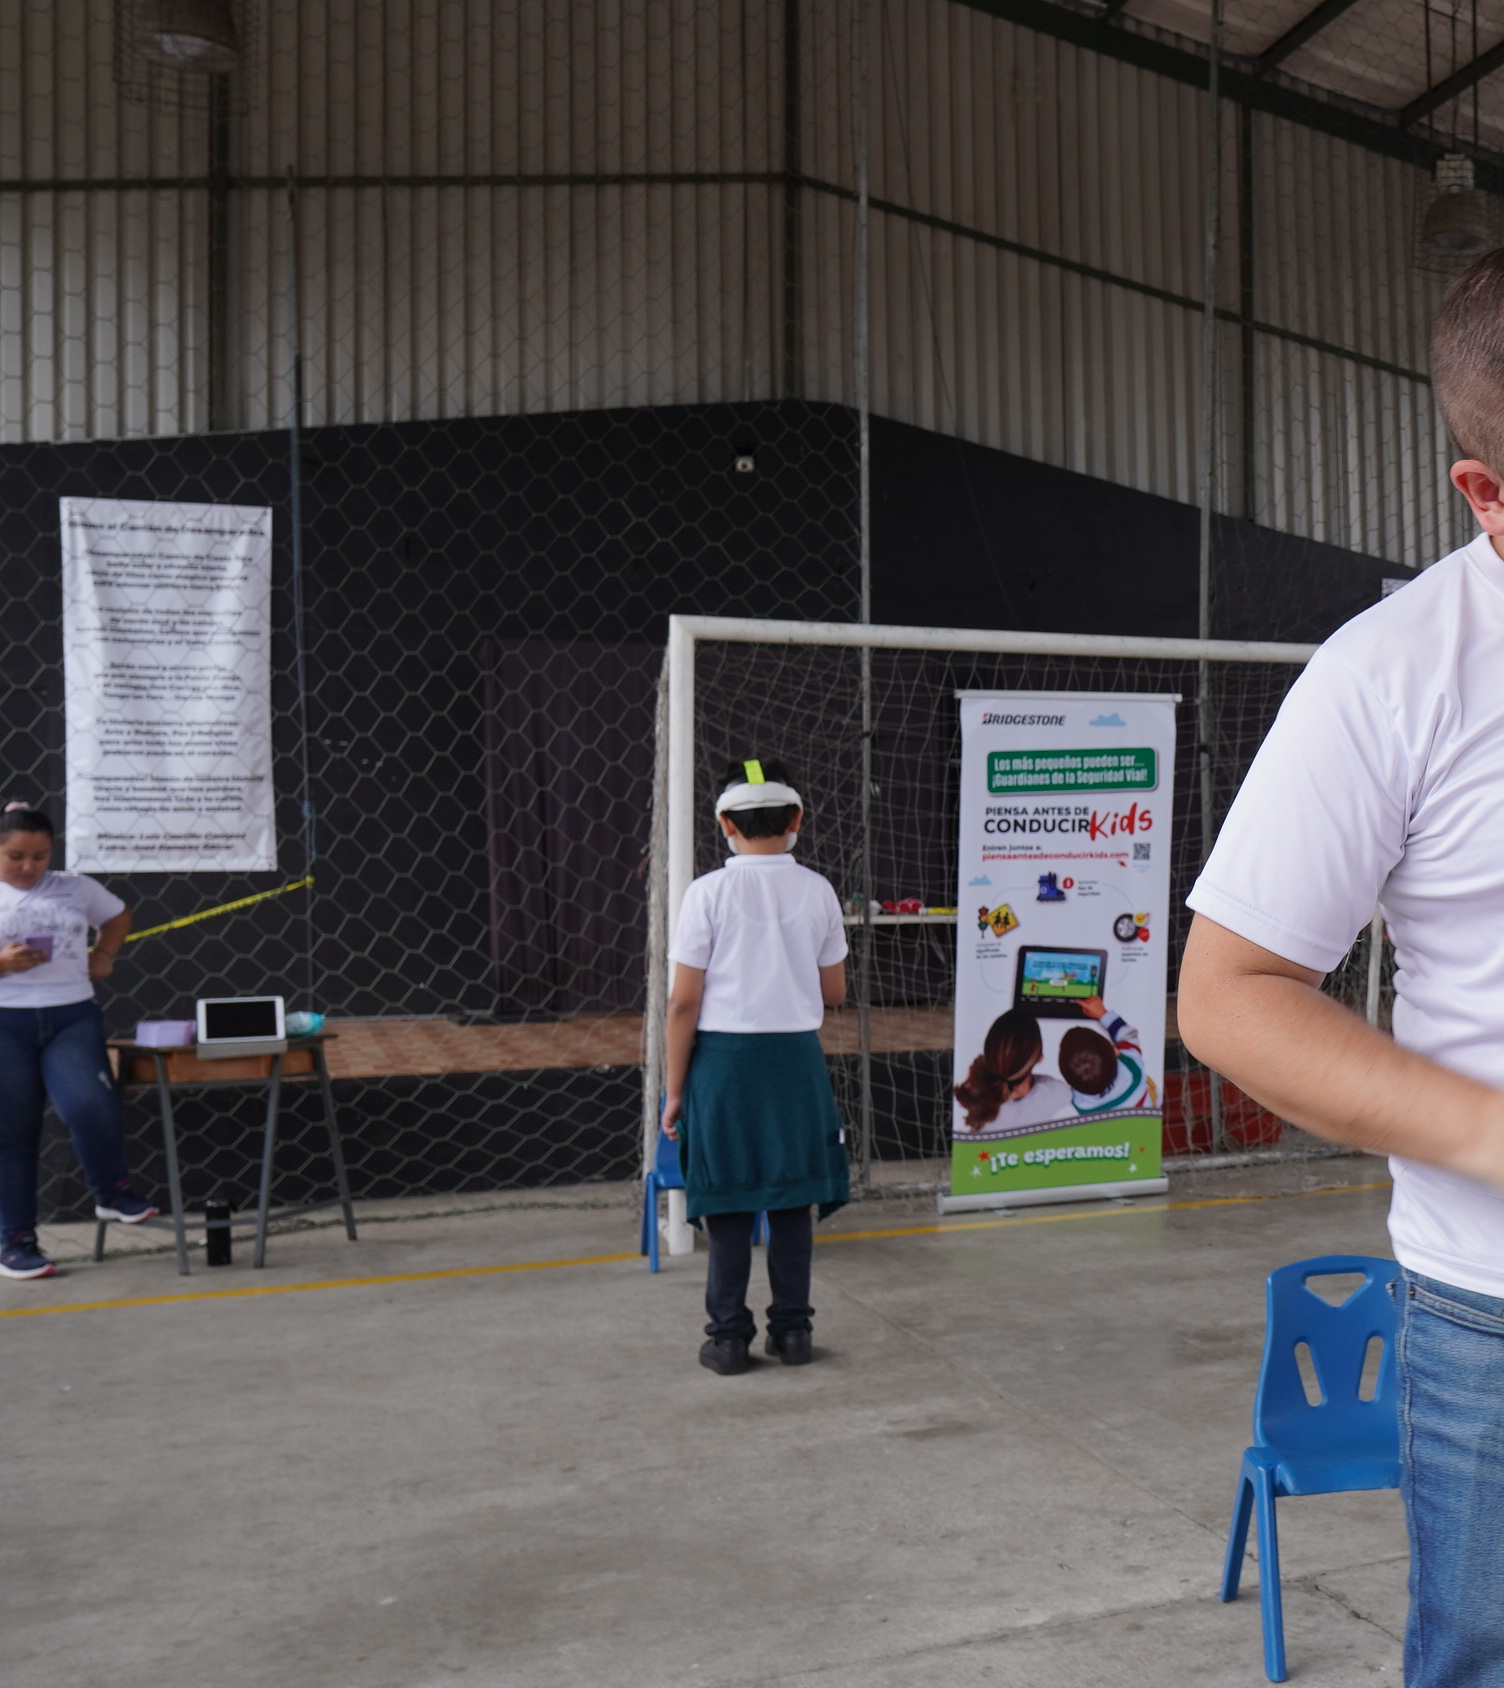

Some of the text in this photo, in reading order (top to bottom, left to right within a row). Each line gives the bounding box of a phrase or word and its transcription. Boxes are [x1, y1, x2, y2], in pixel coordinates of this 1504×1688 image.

[982, 712, 1066, 726] BRIDGESTONE
[994, 758, 1010, 771] Los
[1012, 756, 1033, 770] más
[1035, 755, 1082, 771] pequeños
[1083, 754, 1118, 769] pueden
[992, 768, 1148, 788] ¡Guardianes de la Seguridad Vial!
[985, 806, 1090, 816] PIENSA ANTES DE
[984, 802, 1153, 842] CONDUCIR Kids
[982, 851, 1129, 861] piensaantesdeconducirkids.com
[990, 1142, 1131, 1173] ¡Te esperamos!
